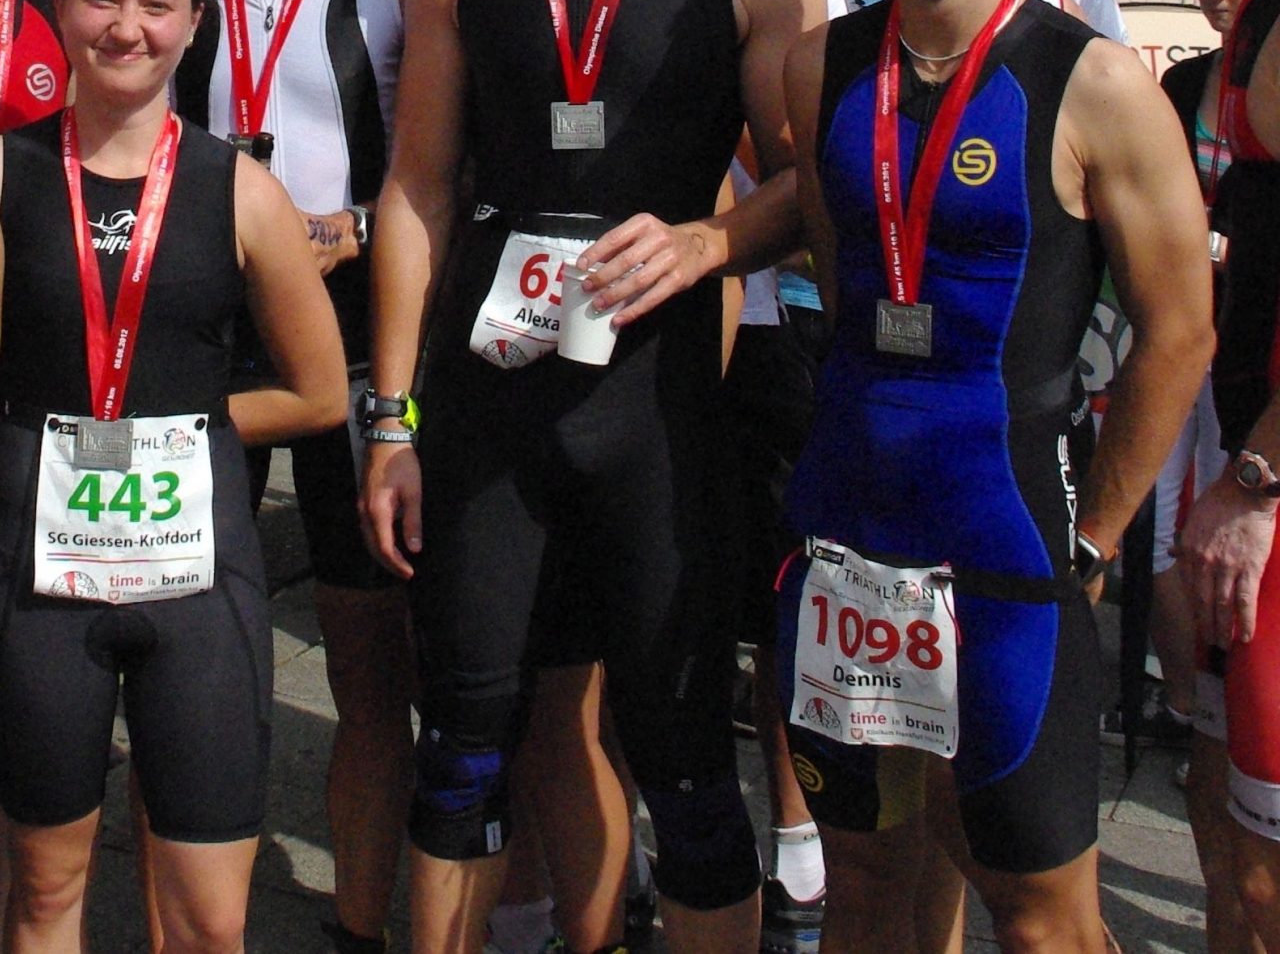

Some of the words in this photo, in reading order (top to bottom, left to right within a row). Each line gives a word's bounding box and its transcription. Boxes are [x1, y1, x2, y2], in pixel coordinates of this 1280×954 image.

[232, 22, 243, 58] Olympische
[582, 32, 601, 75] Olympische
[594, 5, 608, 32] Distanz
[881, 71, 889, 114] Olympische
[882, 161, 892, 202] 05.08.2012
[888, 222, 896, 234] km
[91, 235, 131, 254] ailfis
[890, 236, 898, 244] 10
[131, 238, 148, 282] Olympische
[892, 252, 900, 264] km
[895, 283, 904, 295] km
[113, 328, 128, 369] 05.08.2012
[107, 386, 116, 400] km
[67, 471, 182, 522] 443
[48, 532, 68, 544] SG
[73, 529, 202, 547] Giessen-Krofdorf
[109, 573, 143, 586] time
[148, 578, 156, 586] is
[162, 572, 199, 586] brain
[811, 595, 943, 671] 1098
[833, 665, 902, 689] Dennis
[850, 712, 887, 725] time
[891, 717, 900, 725] is
[905, 715, 944, 734] brain
